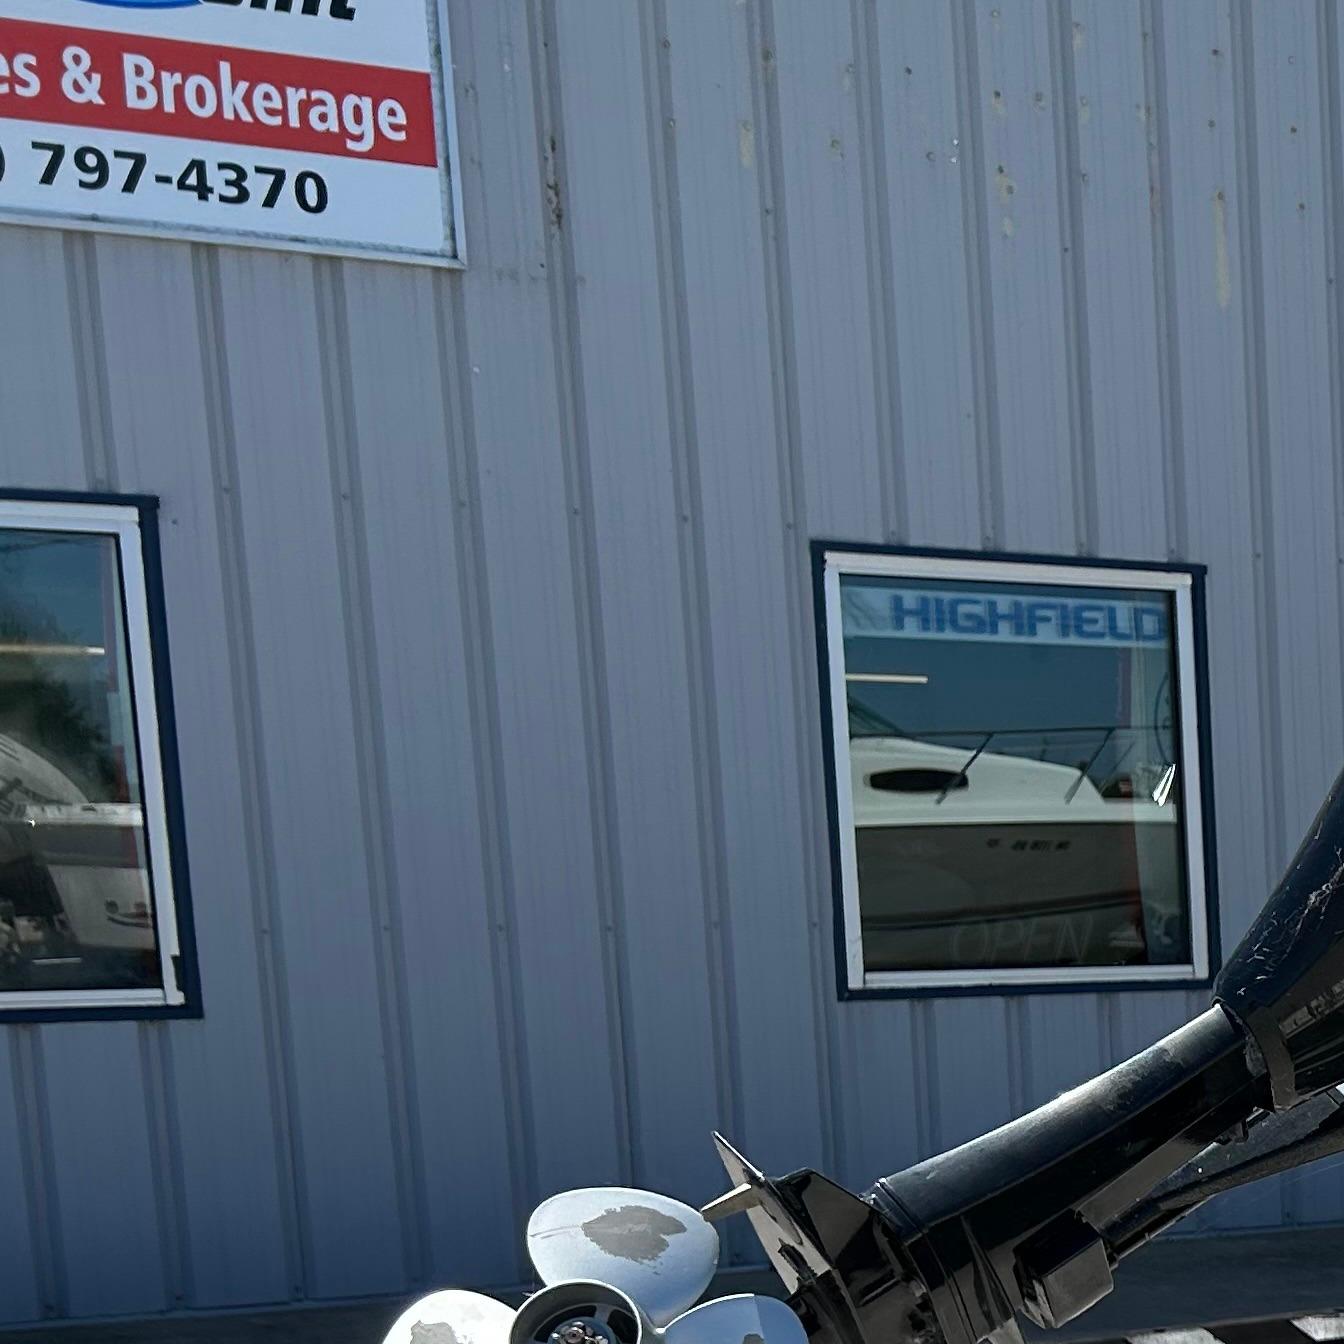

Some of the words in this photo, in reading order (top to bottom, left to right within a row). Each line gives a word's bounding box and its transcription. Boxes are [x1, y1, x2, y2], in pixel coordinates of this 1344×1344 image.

[61, 45, 105, 105] &
[122, 52, 408, 152] Brokerage
[31, 141, 328, 214] 797-4370
[892, 595, 1166, 642] HIGHFIELD
